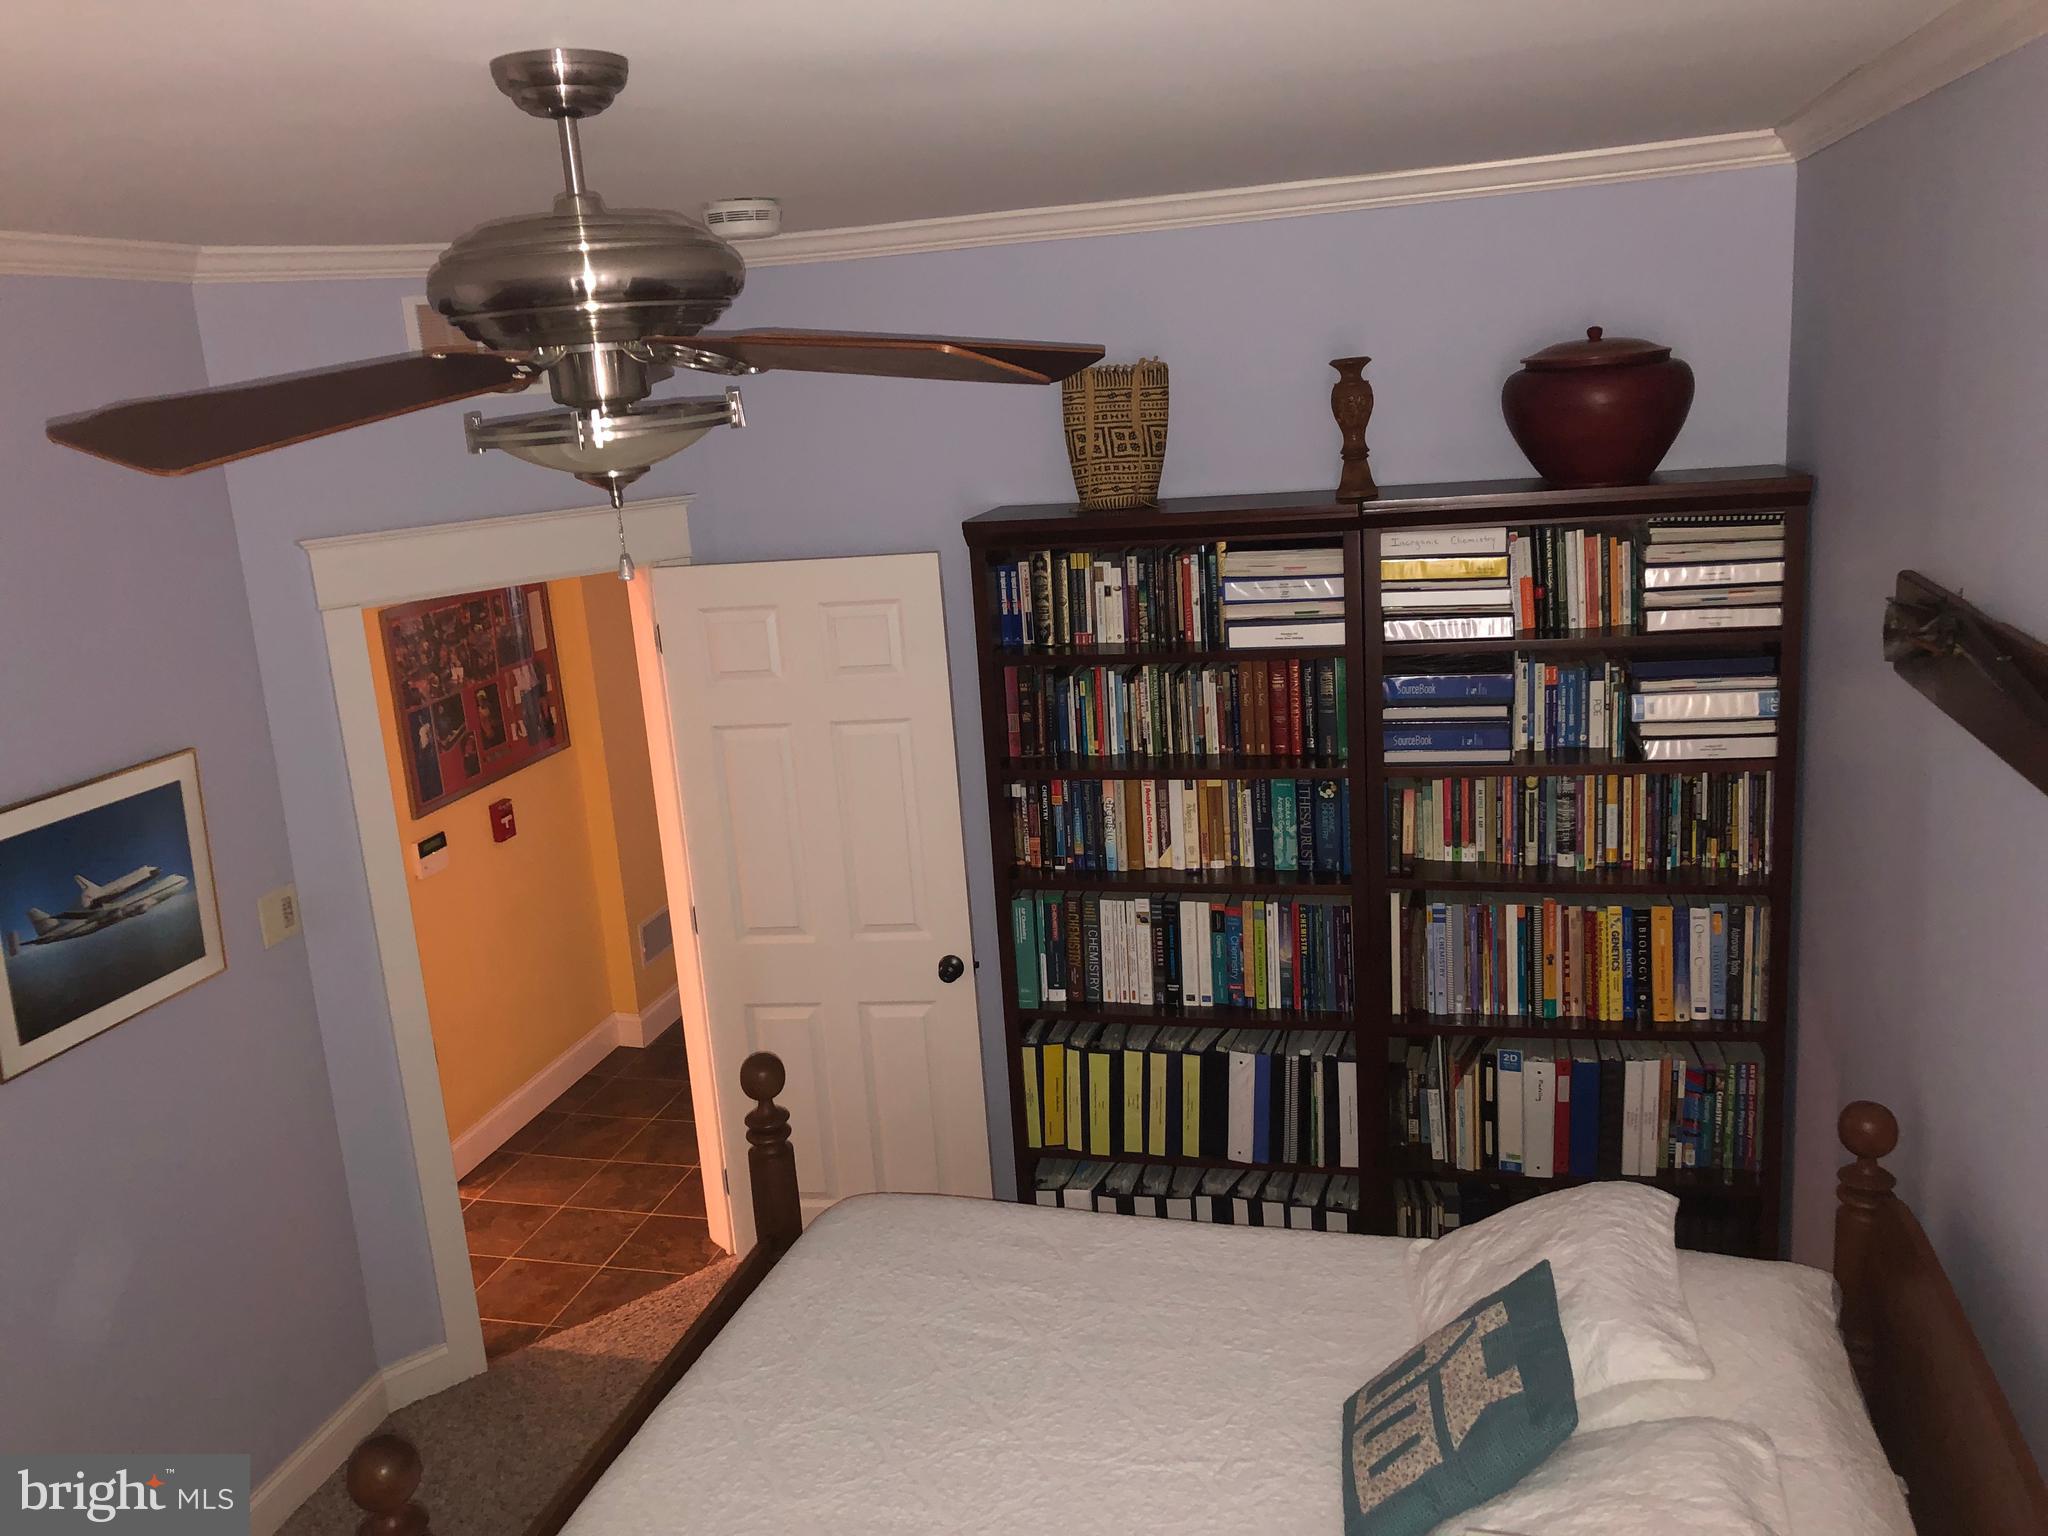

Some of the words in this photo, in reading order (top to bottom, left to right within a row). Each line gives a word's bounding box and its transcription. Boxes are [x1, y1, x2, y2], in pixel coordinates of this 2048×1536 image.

[1389, 536, 1440, 550] Inorganic
[1450, 534, 1496, 550] Chemistry
[1396, 682, 1437, 696] SourceBook
[1391, 734, 1433, 747] SourceBook
[1041, 785, 1049, 821] CHEMISTRY
[1105, 797, 1116, 844] Chemistry
[1145, 787, 1153, 817] Analytical
[1146, 817, 1154, 845] Chemistry
[1299, 786, 1312, 859] THESAURUS
[1321, 802, 1329, 841] CHEMISTRY
[1067, 912, 1081, 968] CHEMISTRY
[1155, 927, 1165, 967] CHEMISTRY
[1299, 913, 1308, 956] CHEMISTRY
[1611, 930, 1621, 972] GENETICS
[1730, 927, 1742, 959] Astronomy
[1087, 929, 1100, 991] CHEMISTRY
[1230, 935, 1240, 979] Chemistry
[1438, 936, 1446, 978] CHEMISTRY
[1625, 948, 1633, 979] GENETICS
[1637, 926, 1648, 982] BIOLOGY
[1729, 959, 1741, 977] Today
[1503, 1053, 1519, 1063] 2D
[1715, 1090, 1725, 1125] CHEMISTRY
